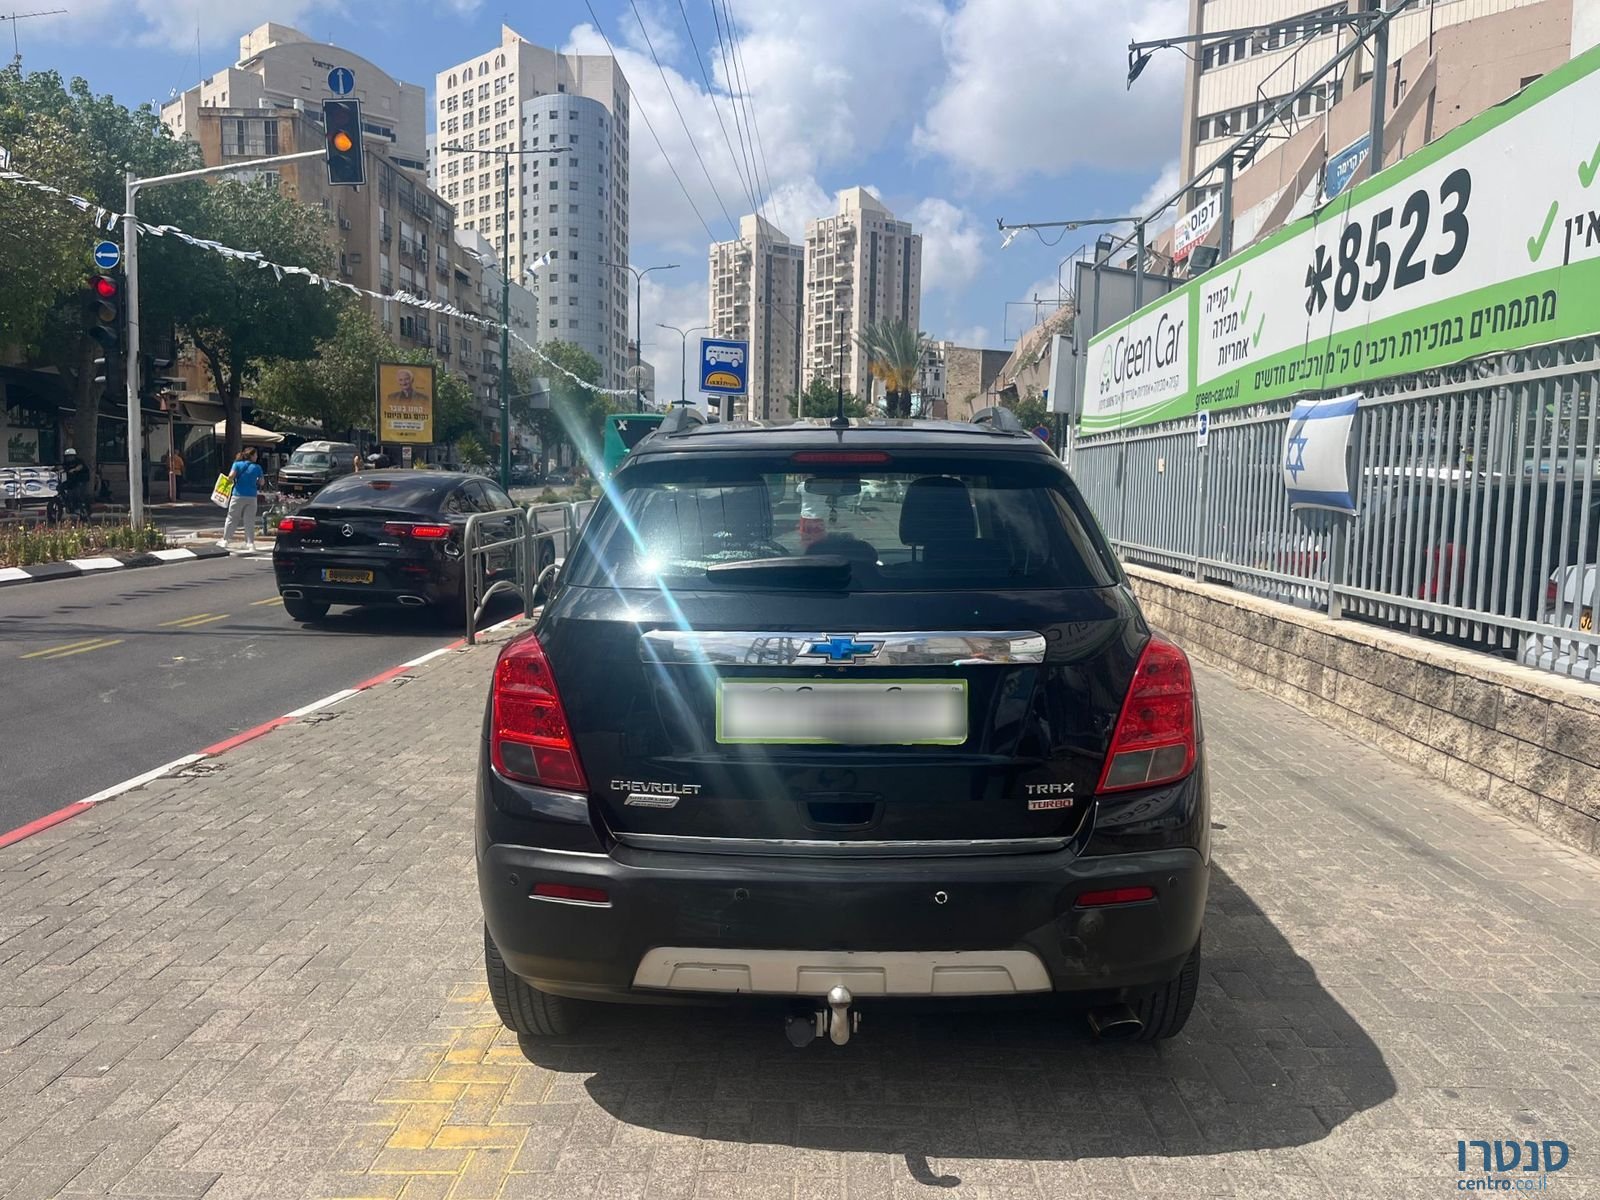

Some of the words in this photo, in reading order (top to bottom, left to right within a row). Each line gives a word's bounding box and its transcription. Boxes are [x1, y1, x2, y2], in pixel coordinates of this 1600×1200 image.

[1337, 154, 1358, 177] קדימה
[1191, 201, 1215, 231] דפוס
[1206, 286, 1229, 313] קנייה
[1212, 312, 1238, 339] מכירה
[1470, 289, 1557, 339] מתמחים
[1113, 335, 1152, 384] Green
[1155, 313, 1184, 368] Car
[1366, 335, 1396, 365] רכבי
[1399, 316, 1463, 357] במכירת
[1217, 337, 1250, 366] אחריות
[1353, 340, 1362, 368] 0
[1254, 365, 1286, 390] חדשים
[1288, 354, 1323, 382] ורכבים
[1195, 380, 1240, 411] green-car.co.il
[610, 780, 702, 795] CHEVROLET
[1025, 782, 1075, 795] TRAX
[1031, 799, 1072, 809] TURBO
